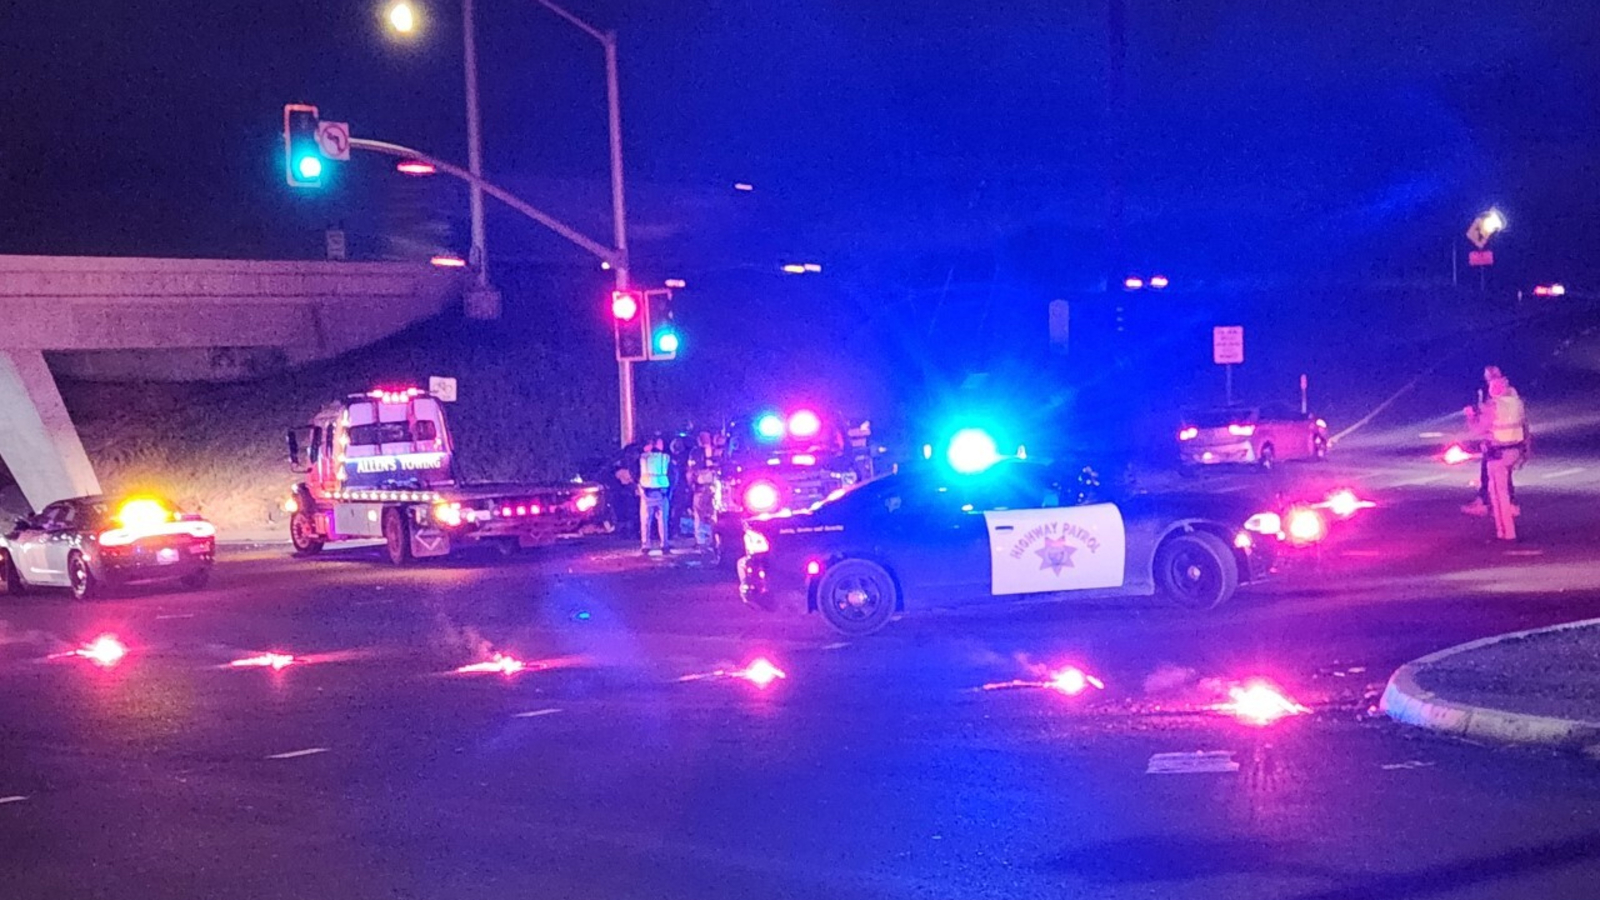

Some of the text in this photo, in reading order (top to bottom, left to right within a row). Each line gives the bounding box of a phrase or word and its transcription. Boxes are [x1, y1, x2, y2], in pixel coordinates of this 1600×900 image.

[400, 457, 441, 471] TOWING
[1010, 521, 1101, 559] HIGHWAY PATROL
